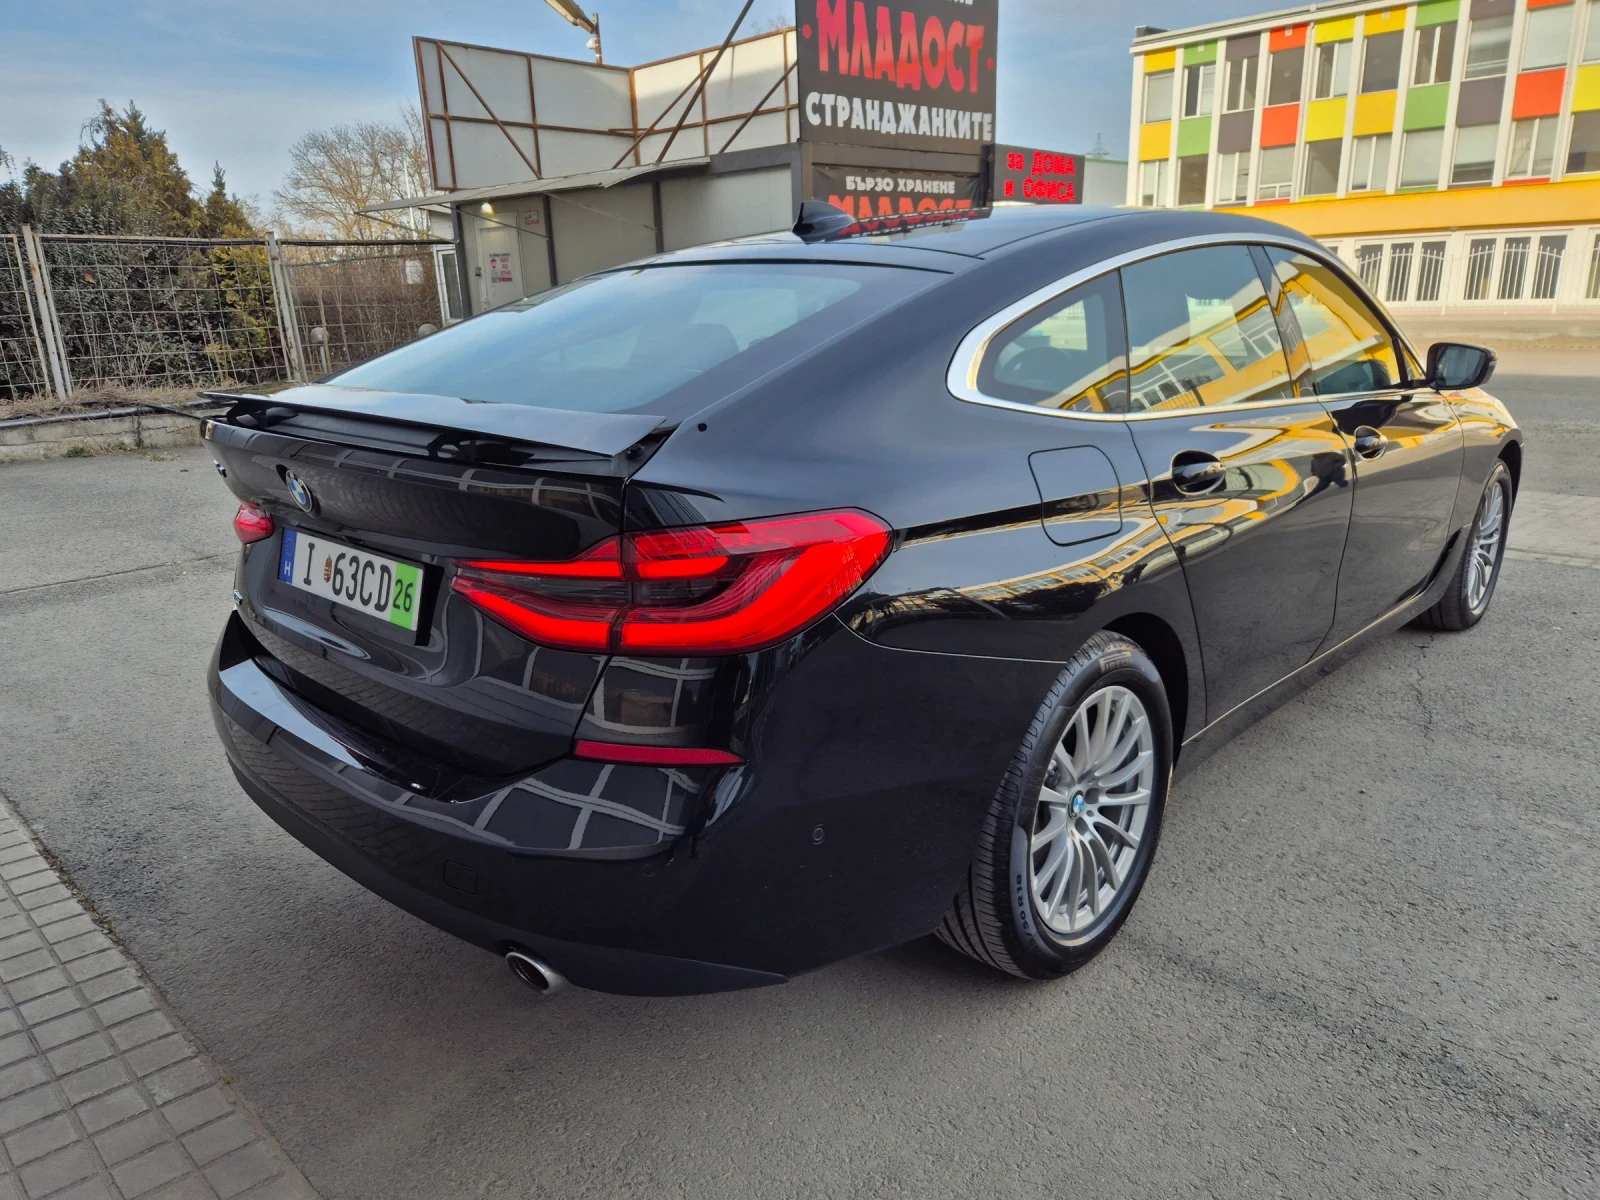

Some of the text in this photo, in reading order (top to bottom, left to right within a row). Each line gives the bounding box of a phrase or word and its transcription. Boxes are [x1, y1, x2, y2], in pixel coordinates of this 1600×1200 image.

[816, 0, 984, 93] МЛАДОСТ
[805, 91, 992, 141] СТРАНДЖАНКИТЕ
[1031, 151, 1075, 176] ДОМА
[846, 176, 956, 194] БЪРЗО ХРАНЕНЕ
[1023, 177, 1075, 203] ОФИСА
[284, 560, 292, 576] H
[332, 552, 392, 612] 63CD
[392, 579, 414, 612] 26
